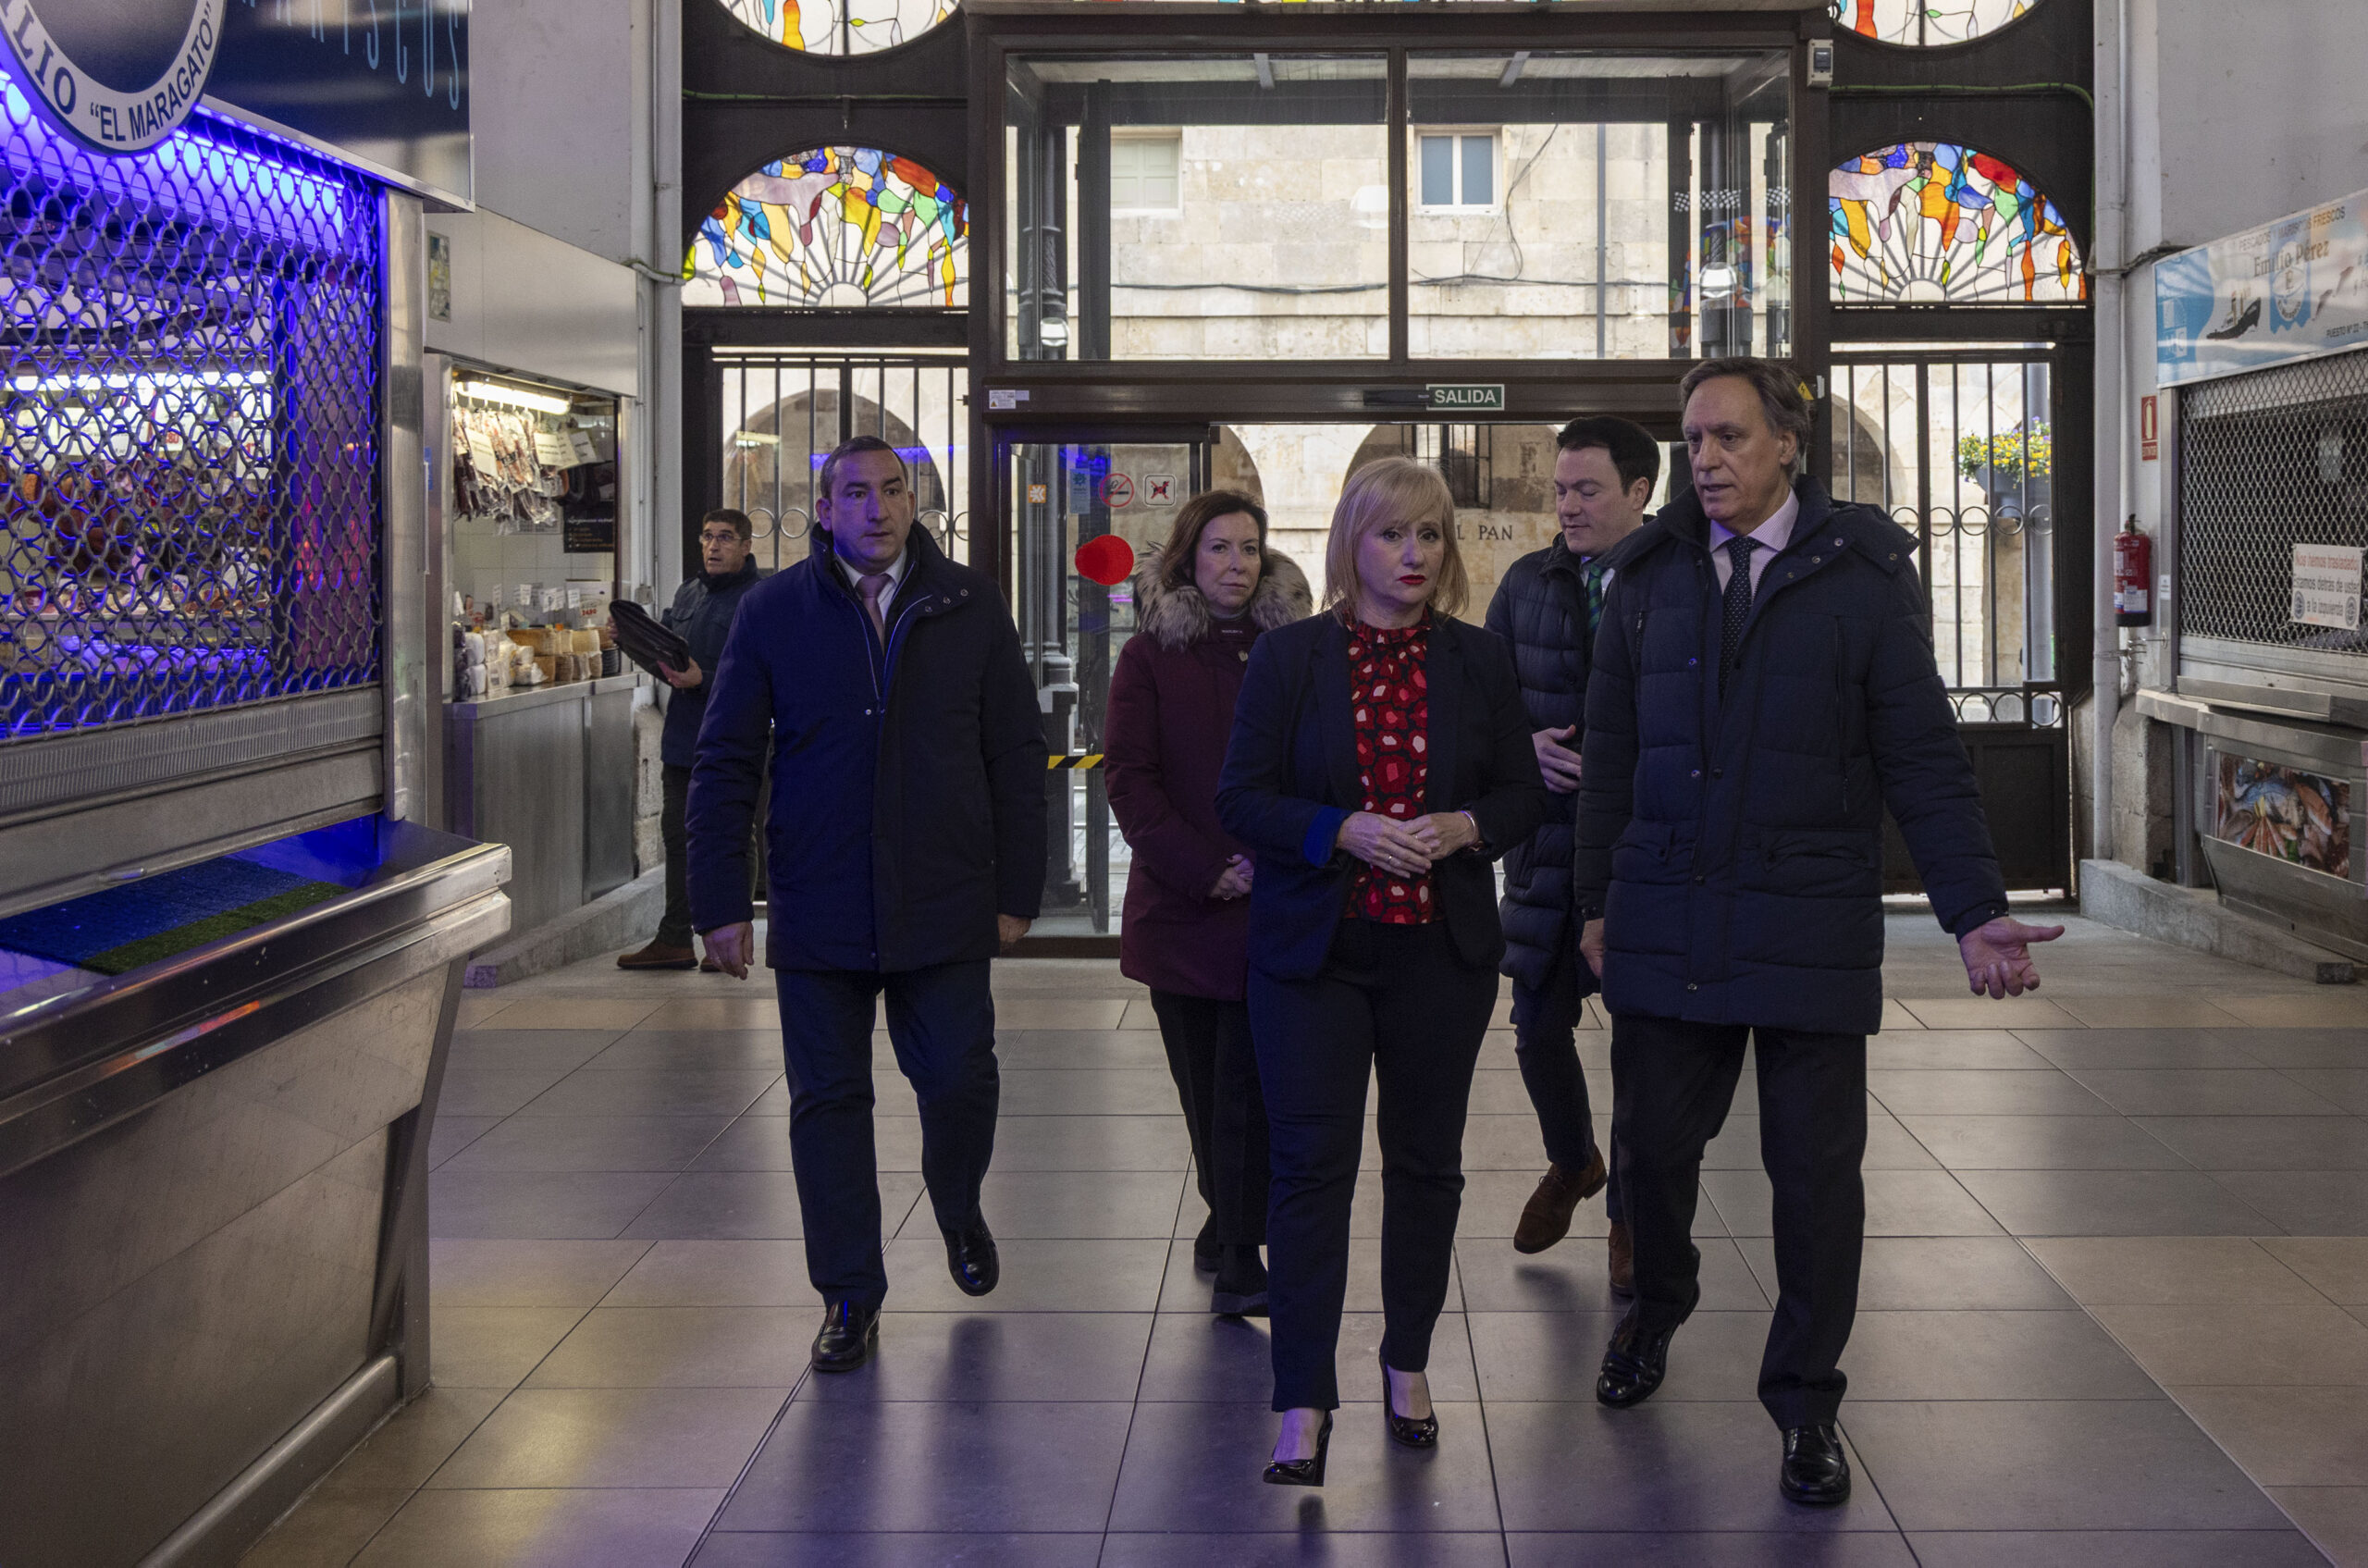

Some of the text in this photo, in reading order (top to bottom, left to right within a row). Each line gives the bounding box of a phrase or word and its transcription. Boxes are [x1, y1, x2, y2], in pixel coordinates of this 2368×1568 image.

[2313, 205, 2346, 227] FRESCOS
[2254, 239, 2330, 278] Emilio Pérez
[1435, 389, 1496, 403] SALIDA
[1478, 525, 1512, 540] PAN
